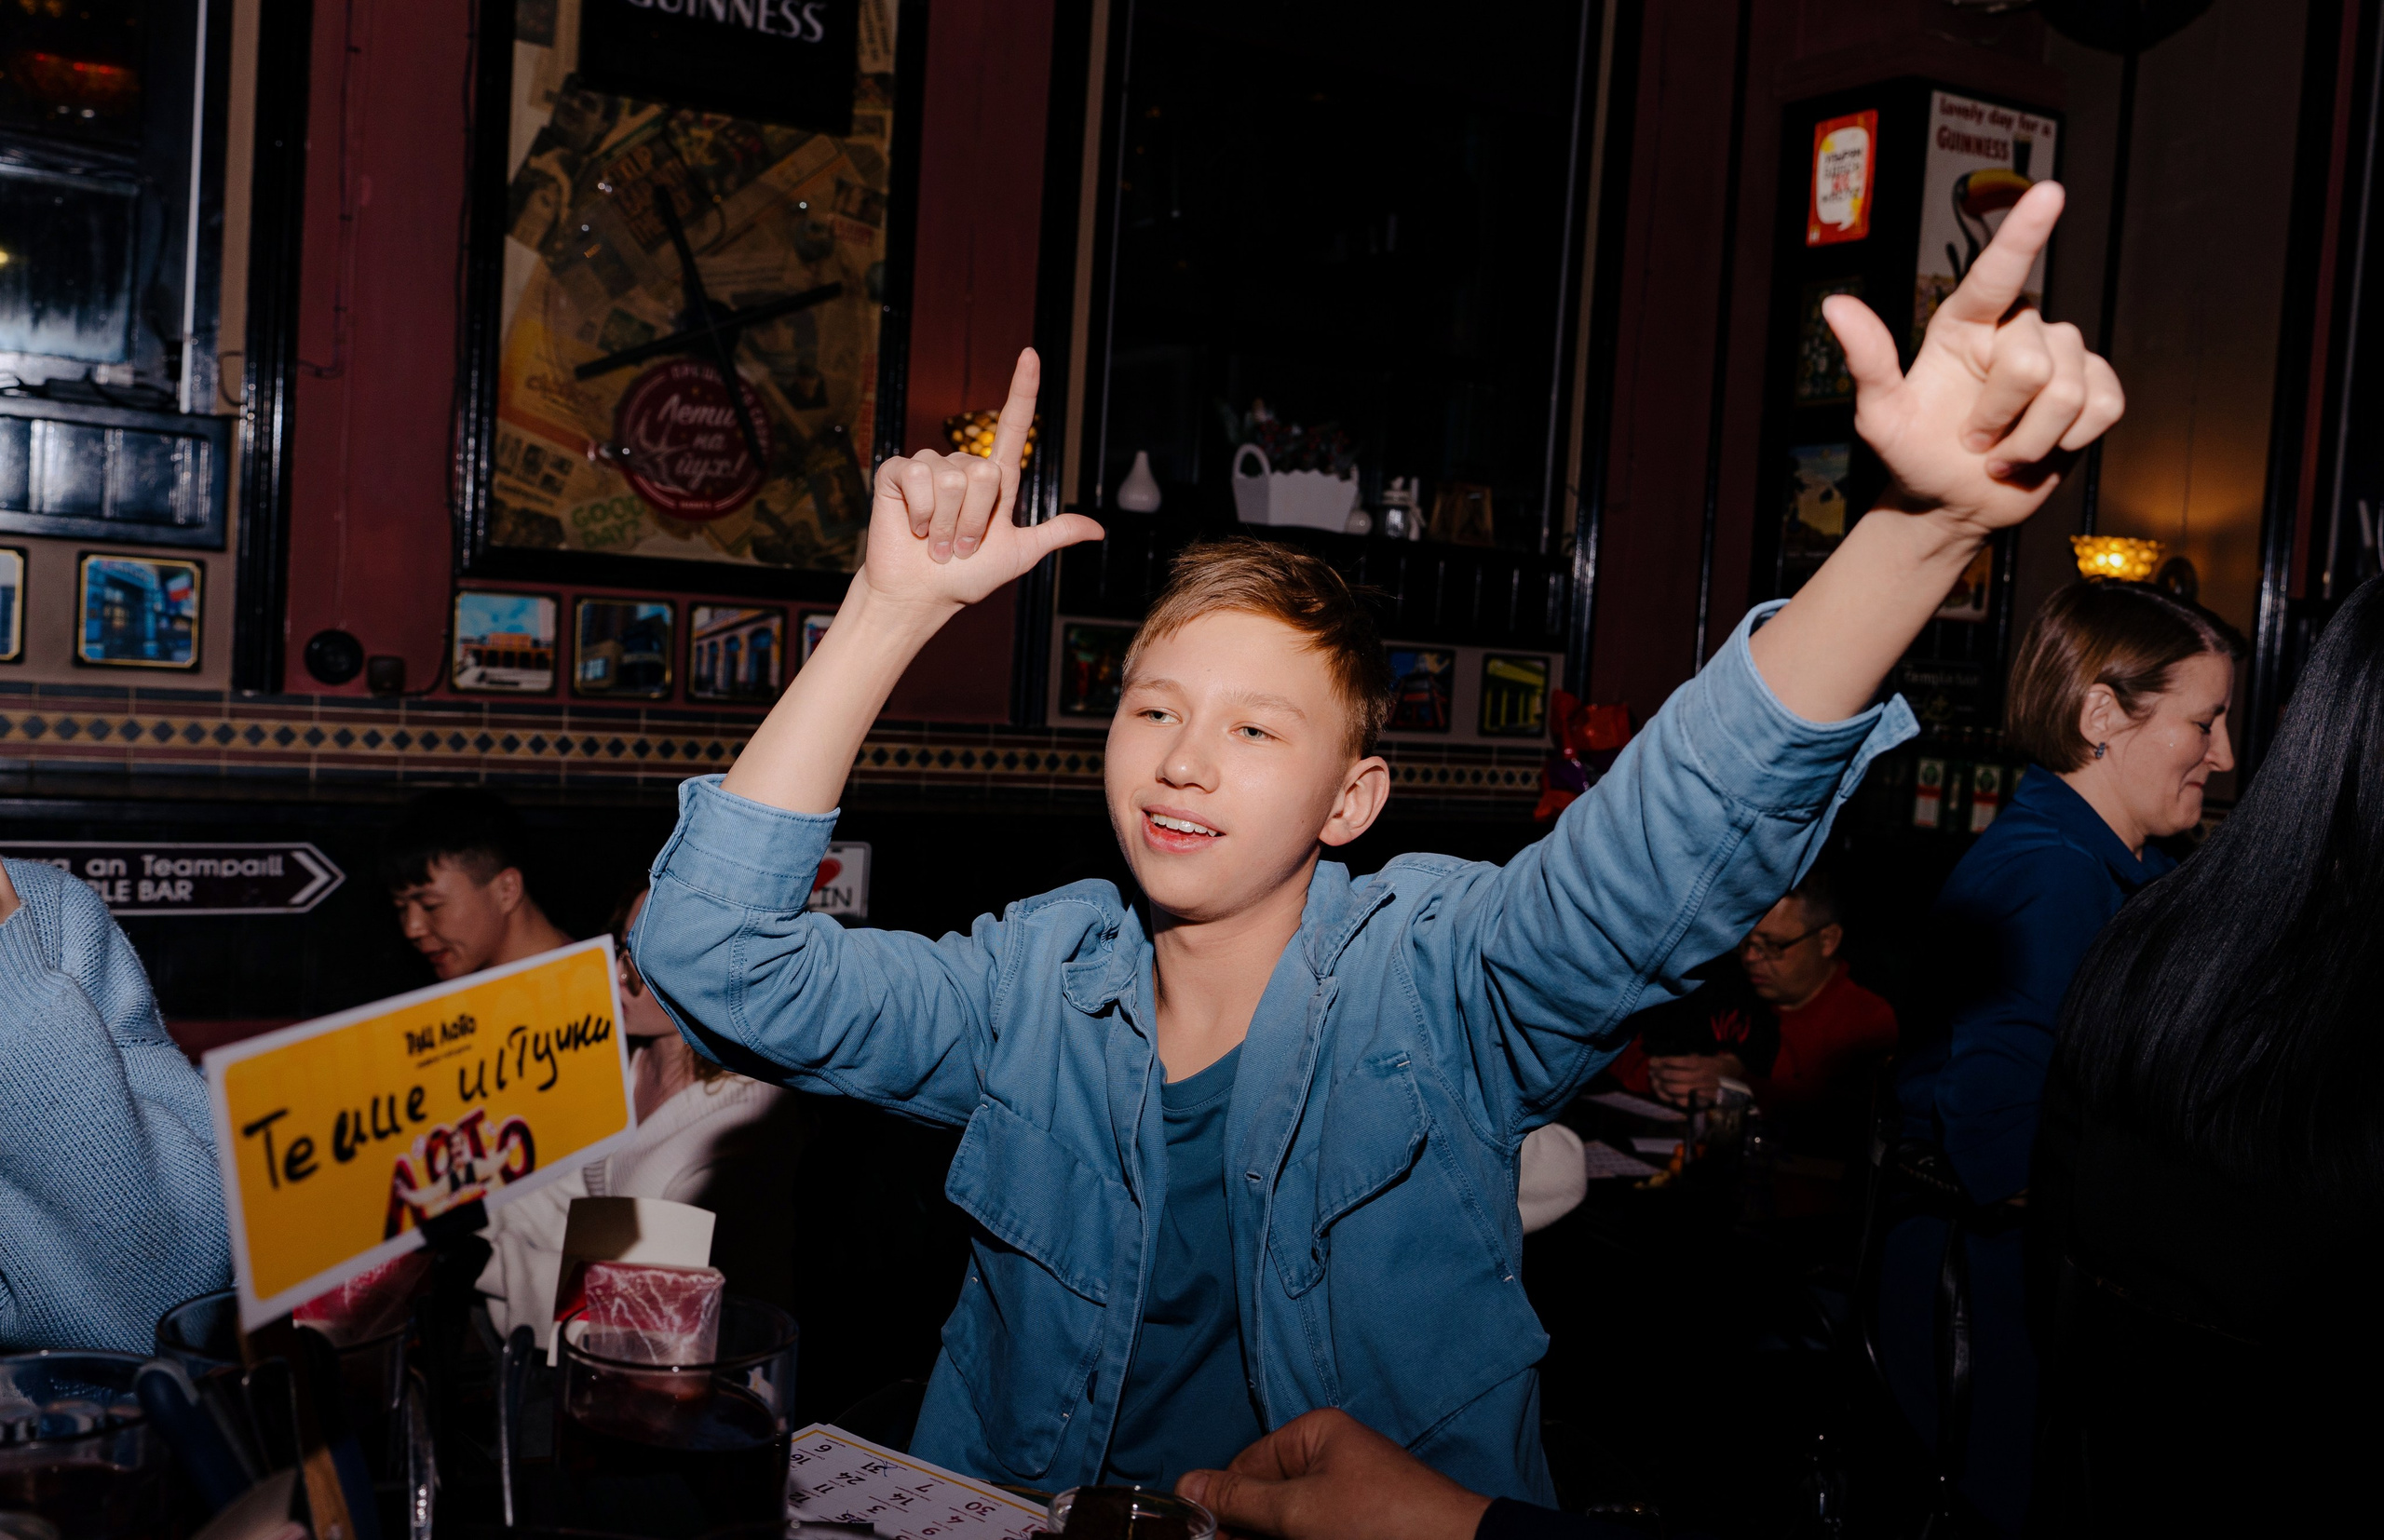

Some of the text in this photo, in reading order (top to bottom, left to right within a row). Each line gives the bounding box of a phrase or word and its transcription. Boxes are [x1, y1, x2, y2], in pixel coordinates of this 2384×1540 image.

[1989, 107, 2013, 131] day
[1936, 125, 2009, 162] GUINNESS
[657, 393, 738, 428] Лети
[692, 431, 726, 452] на
[85, 858, 128, 878] an
[141, 853, 286, 880] Teampaill
[137, 879, 194, 902] BAR
[383, 1109, 535, 1242] ЛОТО
[790, 1453, 812, 1466] 16
[861, 1462, 885, 1474] 31
[835, 1471, 866, 1485] 24
[813, 1483, 834, 1494] 11
[915, 1482, 934, 1493] 7
[788, 1491, 811, 1504] 12
[889, 1493, 914, 1506] 14
[867, 1505, 887, 1515] 3
[965, 1501, 996, 1516] 30
[946, 1515, 964, 1525] 4
